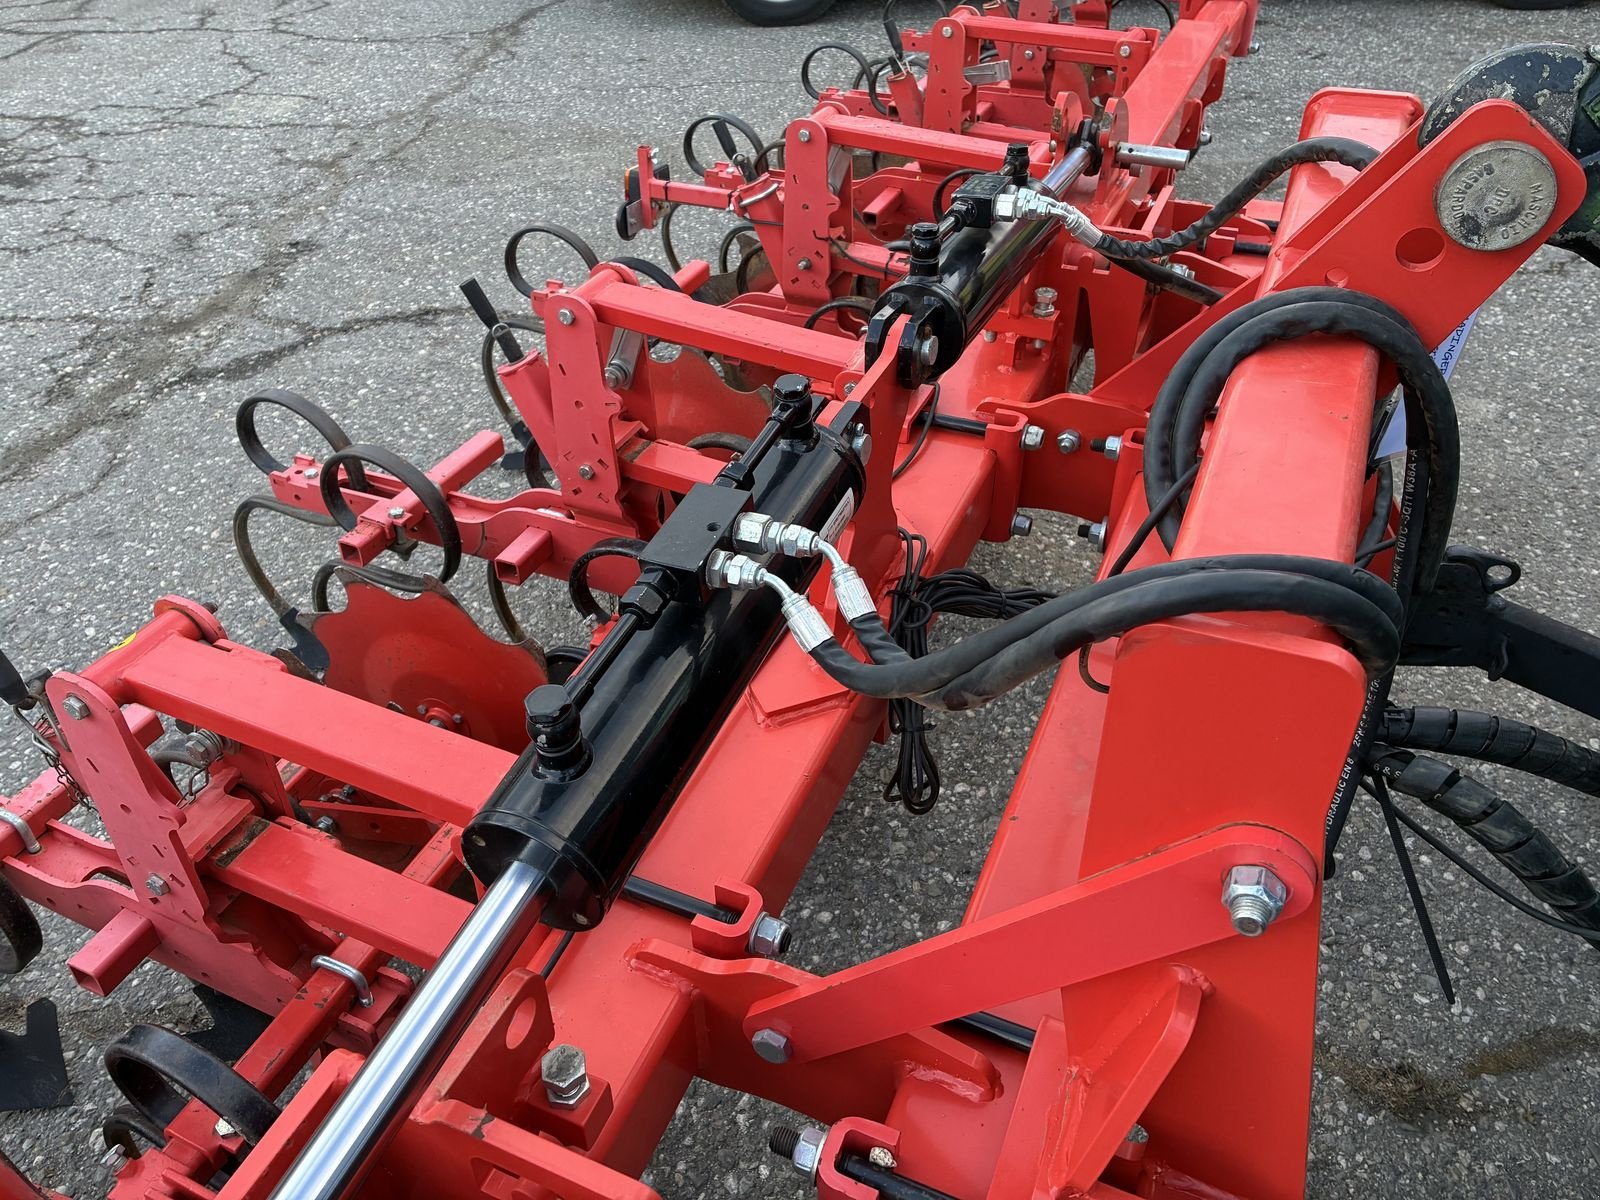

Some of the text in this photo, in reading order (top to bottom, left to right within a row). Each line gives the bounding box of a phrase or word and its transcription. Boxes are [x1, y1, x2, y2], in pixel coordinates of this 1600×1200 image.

[1451, 162, 1496, 220] GASPARDO
[1501, 182, 1544, 240] MASCHIO
[1341, 763, 1352, 780] EN
